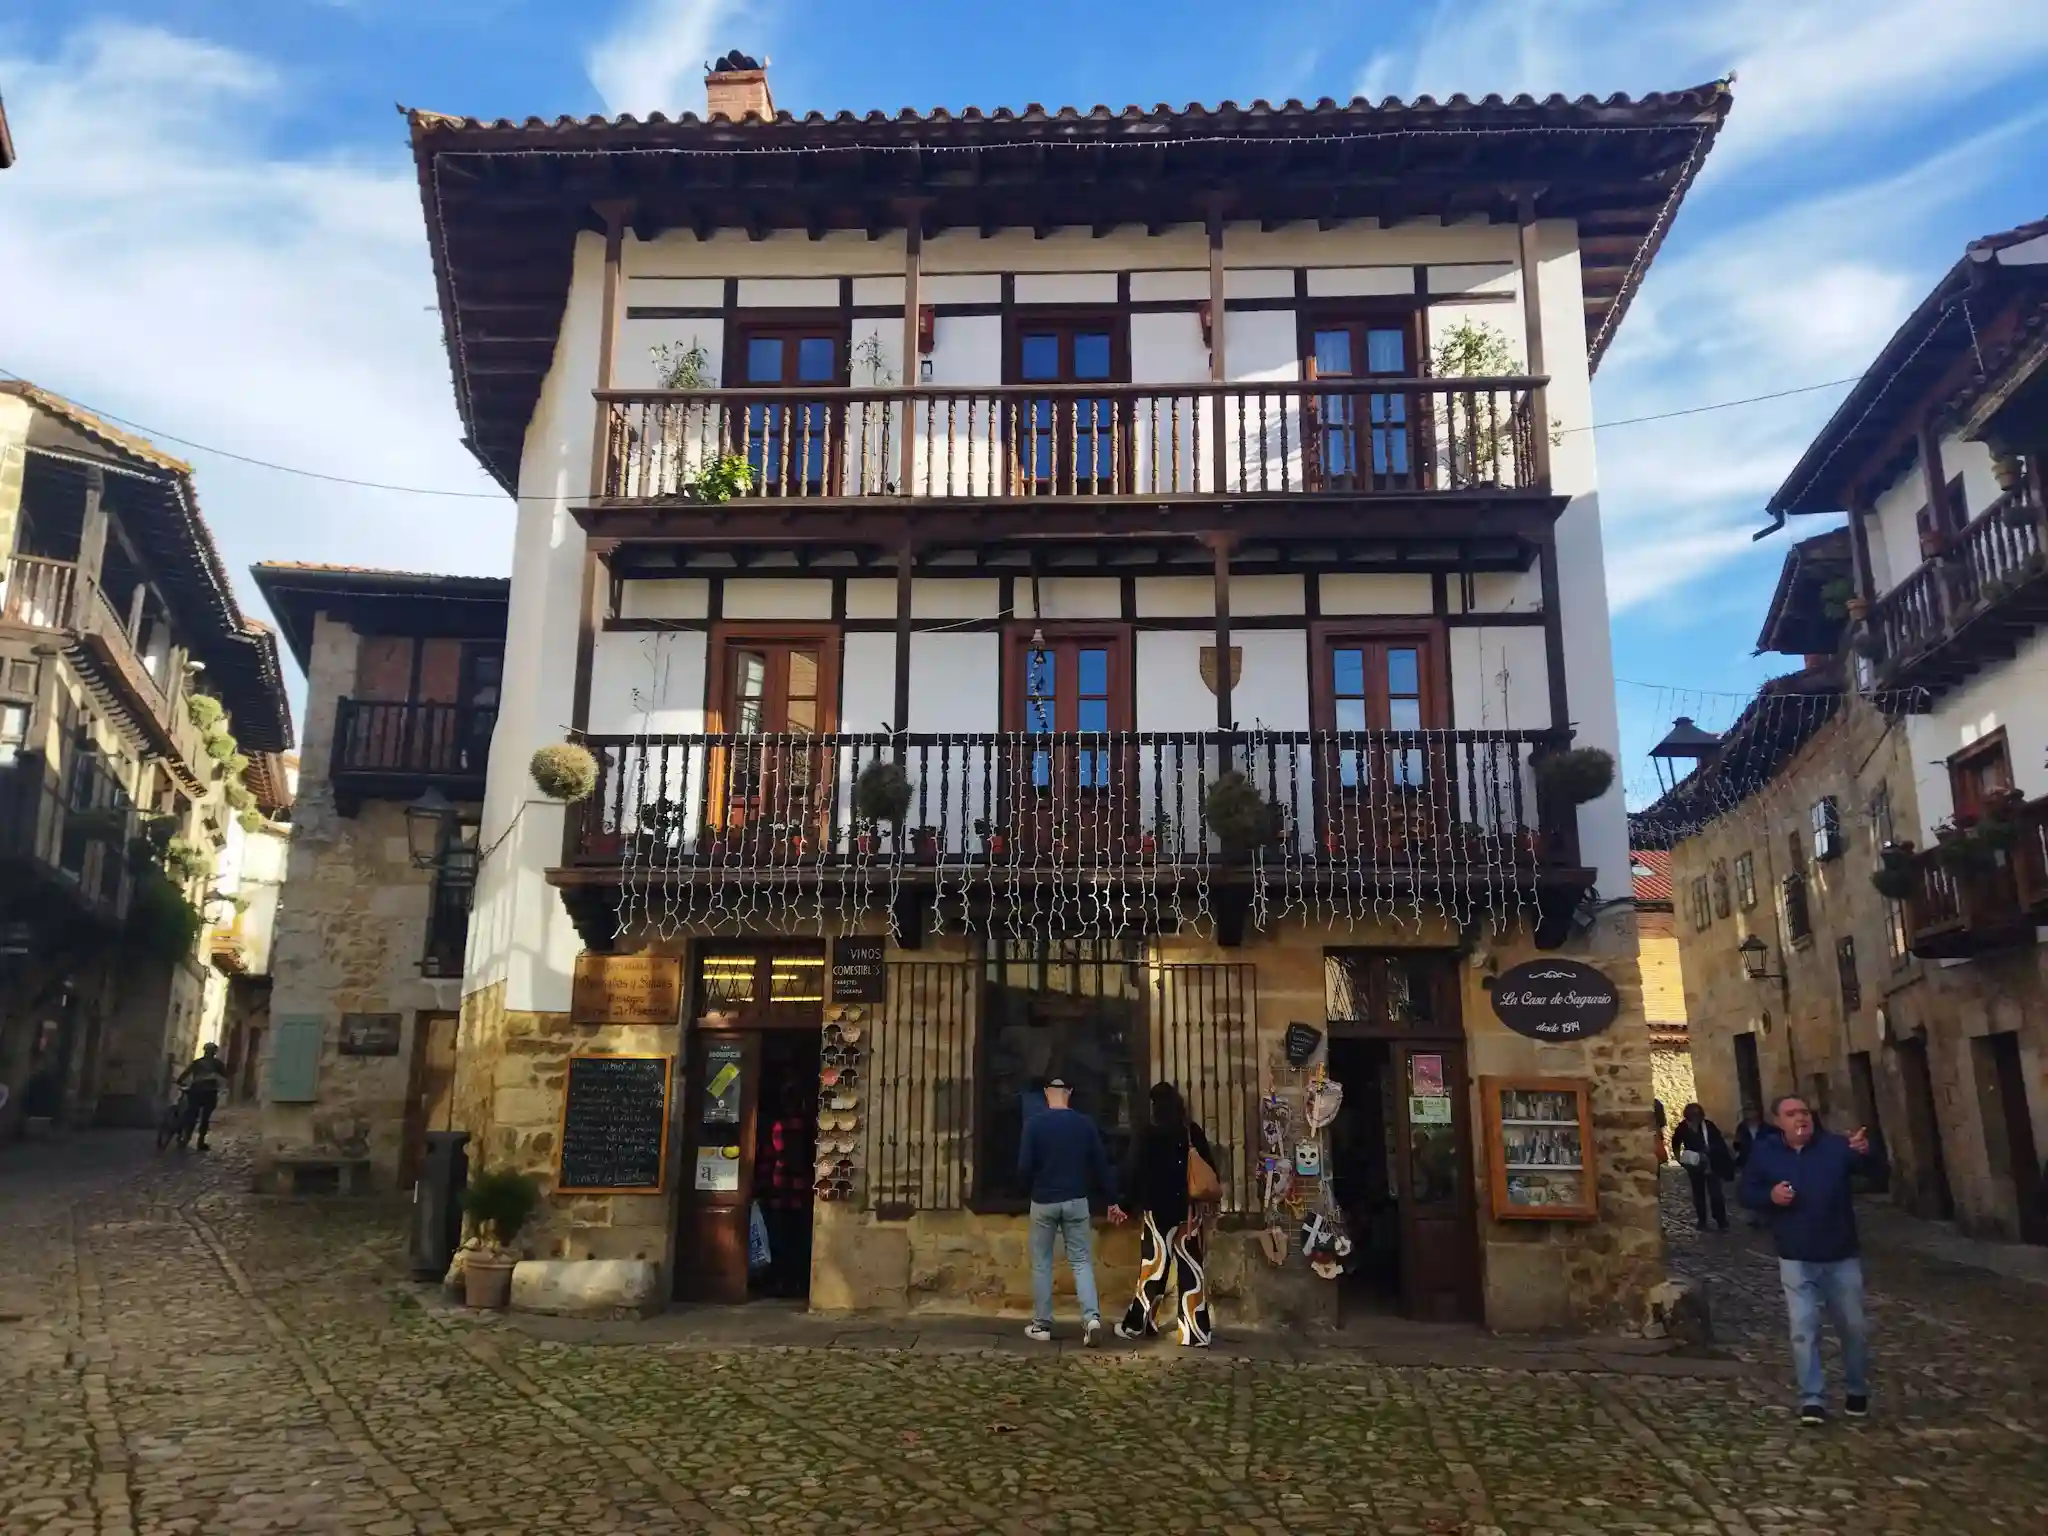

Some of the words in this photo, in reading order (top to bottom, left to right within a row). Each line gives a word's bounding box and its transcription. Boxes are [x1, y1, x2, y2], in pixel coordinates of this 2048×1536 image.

[849, 948, 881, 960] VINOS
[1500, 991, 1518, 1005] La
[1521, 991, 1547, 1005] Casa
[1550, 992, 1562, 1005] de
[1564, 990, 1612, 1008] Sagrario
[1536, 1022, 1559, 1032] desde
